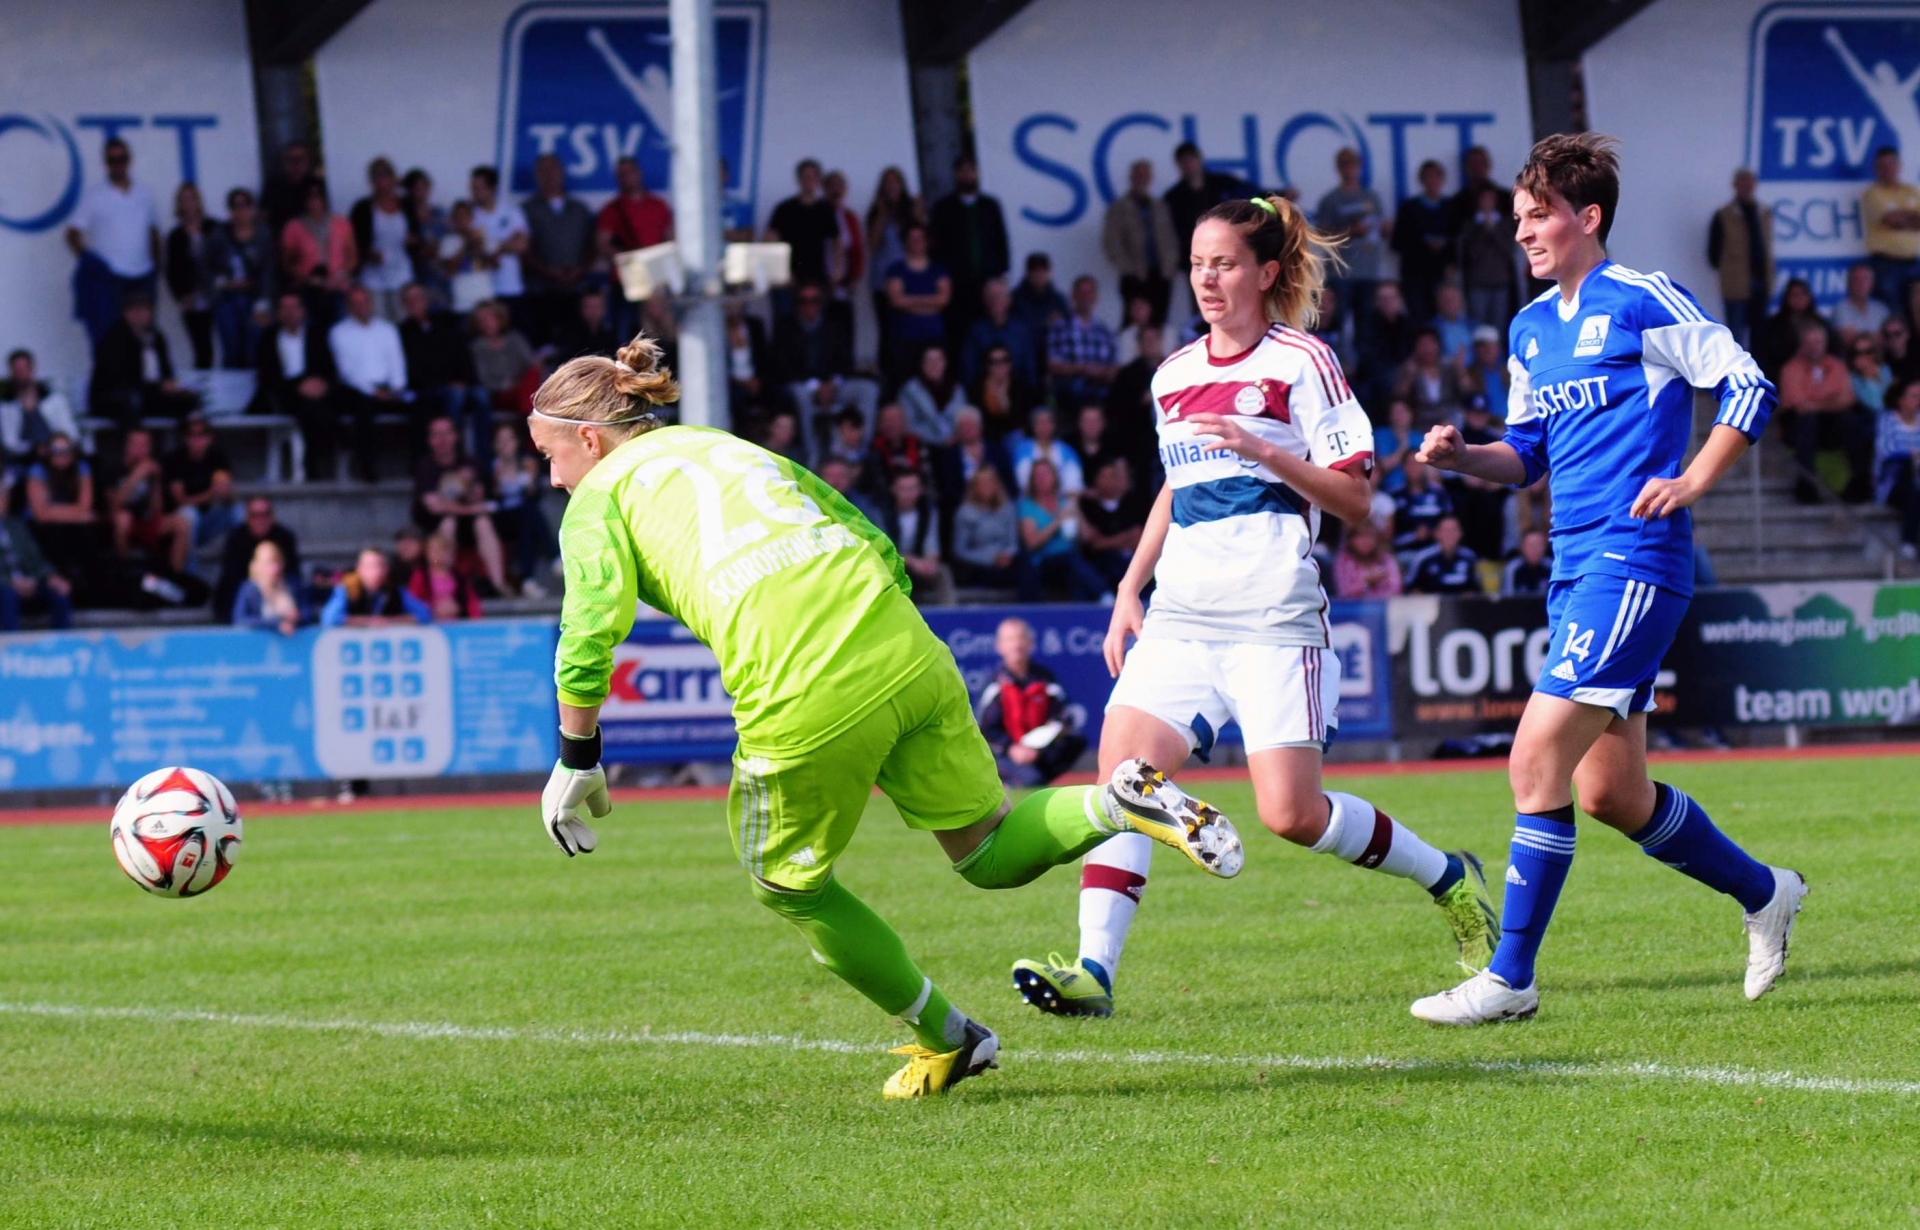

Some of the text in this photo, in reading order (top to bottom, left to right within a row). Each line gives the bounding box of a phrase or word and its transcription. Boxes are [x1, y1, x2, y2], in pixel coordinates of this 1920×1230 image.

[528, 121, 645, 178] TSV
[1773, 116, 1876, 168] TSV
[1011, 112, 1495, 227] SCHOTT
[1533, 375, 1609, 418] SCHOTT
[1561, 622, 1595, 663] 14
[1735, 684, 1832, 721] team
